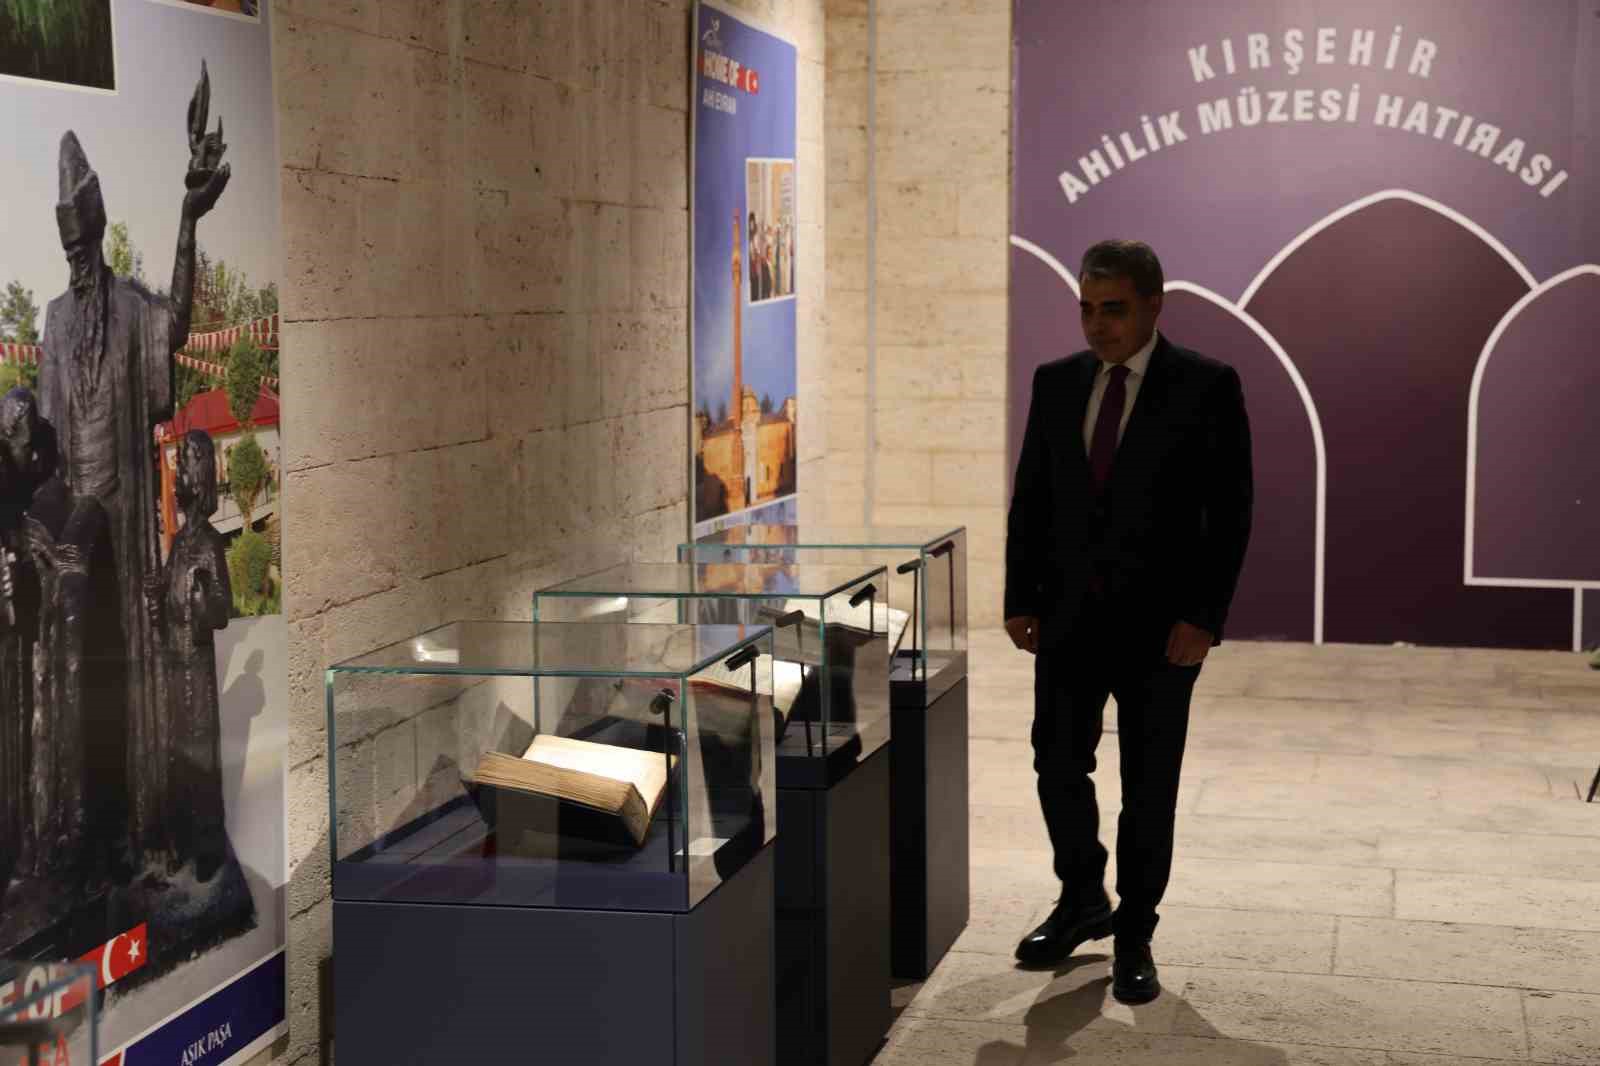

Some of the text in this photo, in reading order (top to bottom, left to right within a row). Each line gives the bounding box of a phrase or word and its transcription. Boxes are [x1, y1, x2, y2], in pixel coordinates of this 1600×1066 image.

[1187, 25, 1437, 83] KIRŞEHİR
[1058, 110, 1188, 204] AHİLİK
[1197, 83, 1362, 134] MÜZESİ
[208, 1022, 233, 1053] PAŞA
